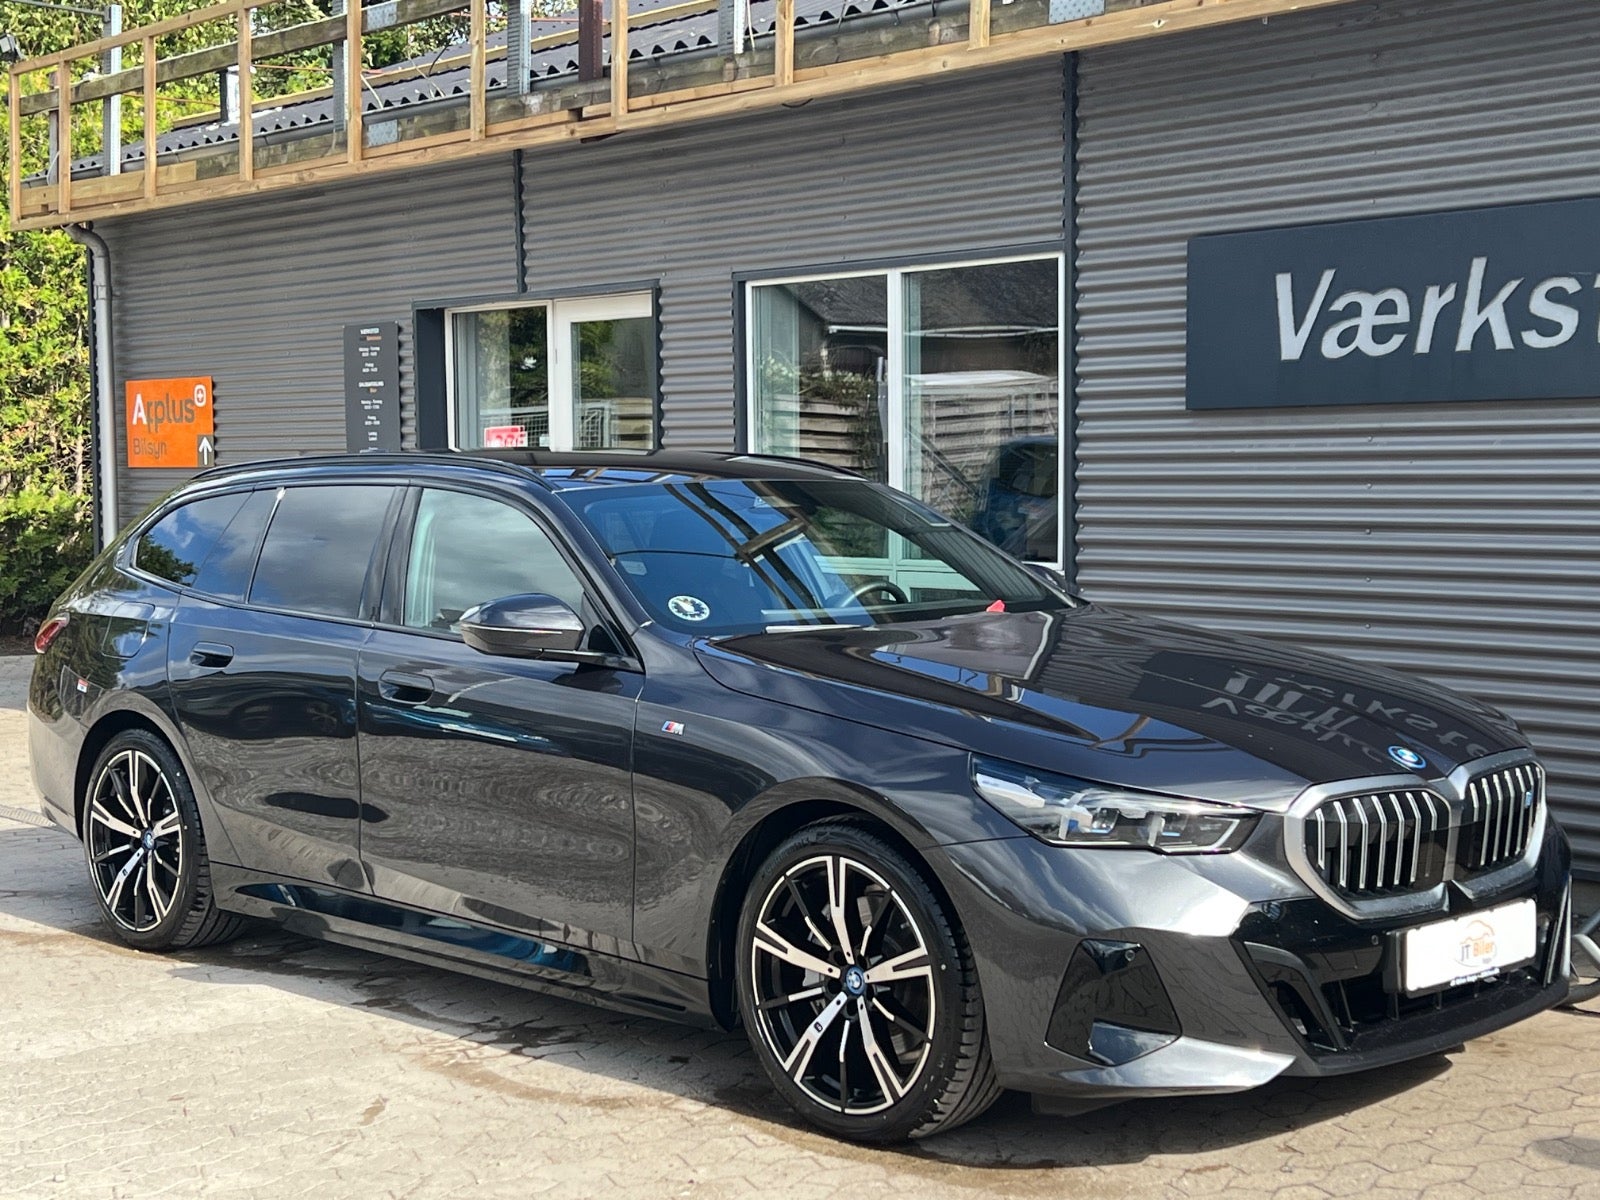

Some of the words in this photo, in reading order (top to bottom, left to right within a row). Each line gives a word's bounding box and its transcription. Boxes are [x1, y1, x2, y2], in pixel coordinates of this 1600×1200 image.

[1275, 256, 1600, 361] Værks
[133, 438, 168, 460] Bilsyn
[1473, 939, 1496, 957] Biler
